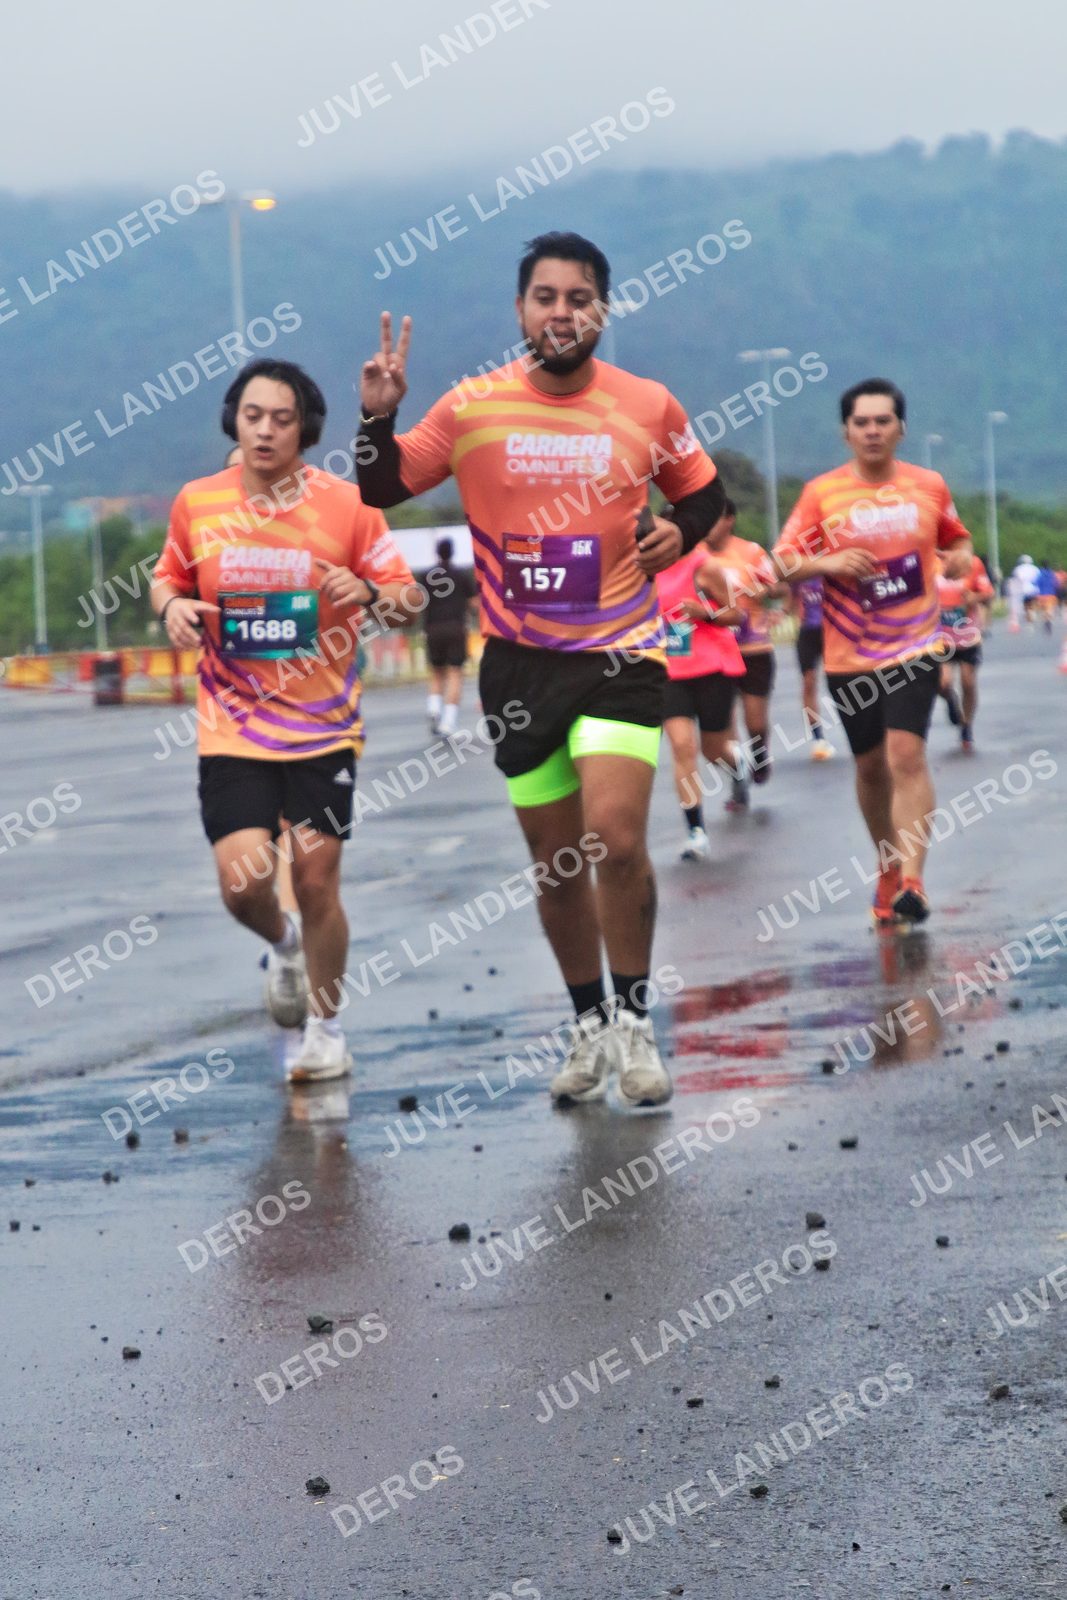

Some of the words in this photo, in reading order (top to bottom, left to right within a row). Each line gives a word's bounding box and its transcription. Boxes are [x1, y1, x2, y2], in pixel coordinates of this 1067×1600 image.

[505, 433, 613, 457] CARRERA
[506, 458, 587, 474] OMNILIFE
[219, 547, 312, 570] CARRERA
[520, 567, 566, 590] 157
[238, 619, 297, 641] 1688
